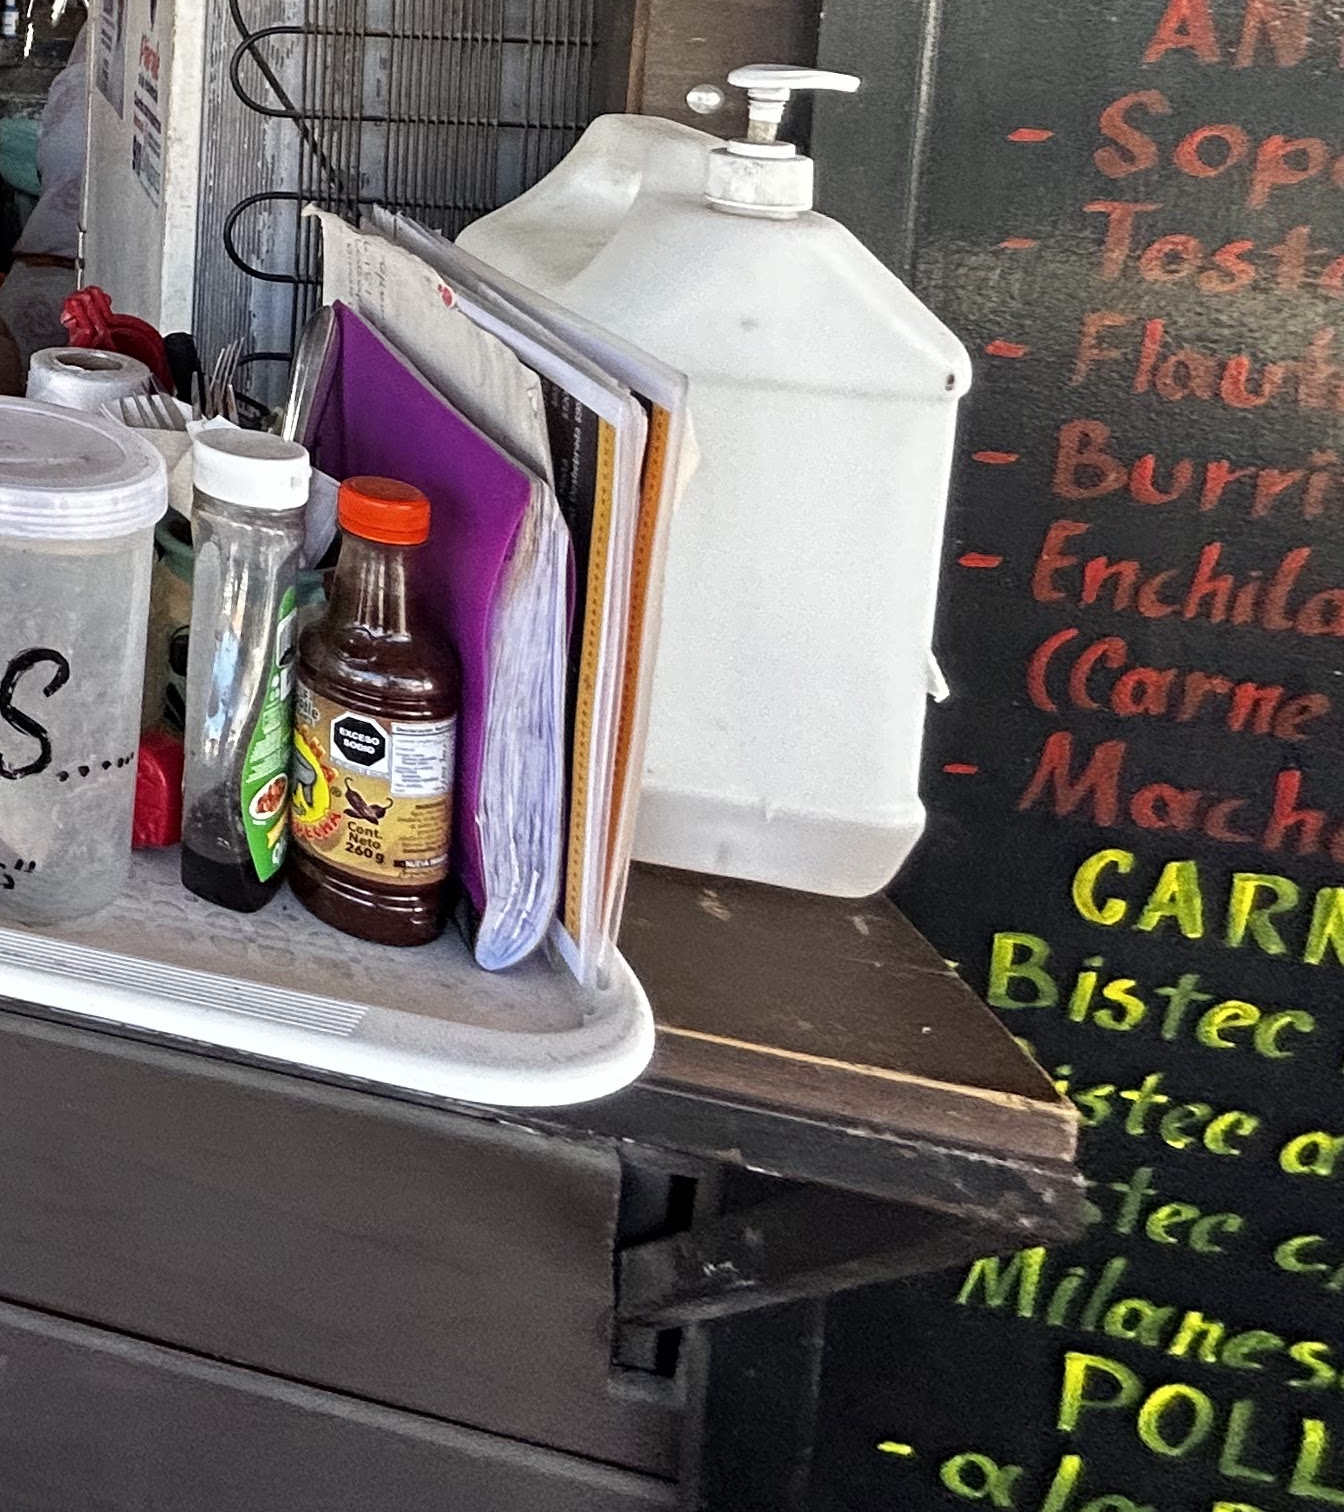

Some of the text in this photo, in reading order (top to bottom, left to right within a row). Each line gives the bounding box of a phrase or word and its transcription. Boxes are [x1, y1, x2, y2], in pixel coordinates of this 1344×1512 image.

[1093, 88, 1344, 210] Sop
[338, 726, 381, 747] EXCESO
[343, 738, 376, 756] SODIO
[1018, 730, 1344, 864] Mach
[346, 819, 384, 840] Cont.
[348, 830, 382, 851] Neto
[344, 841, 386, 865] 260 g
[987, 931, 1315, 1060] Bistec
[957, 1246, 1344, 1389] Milanes
